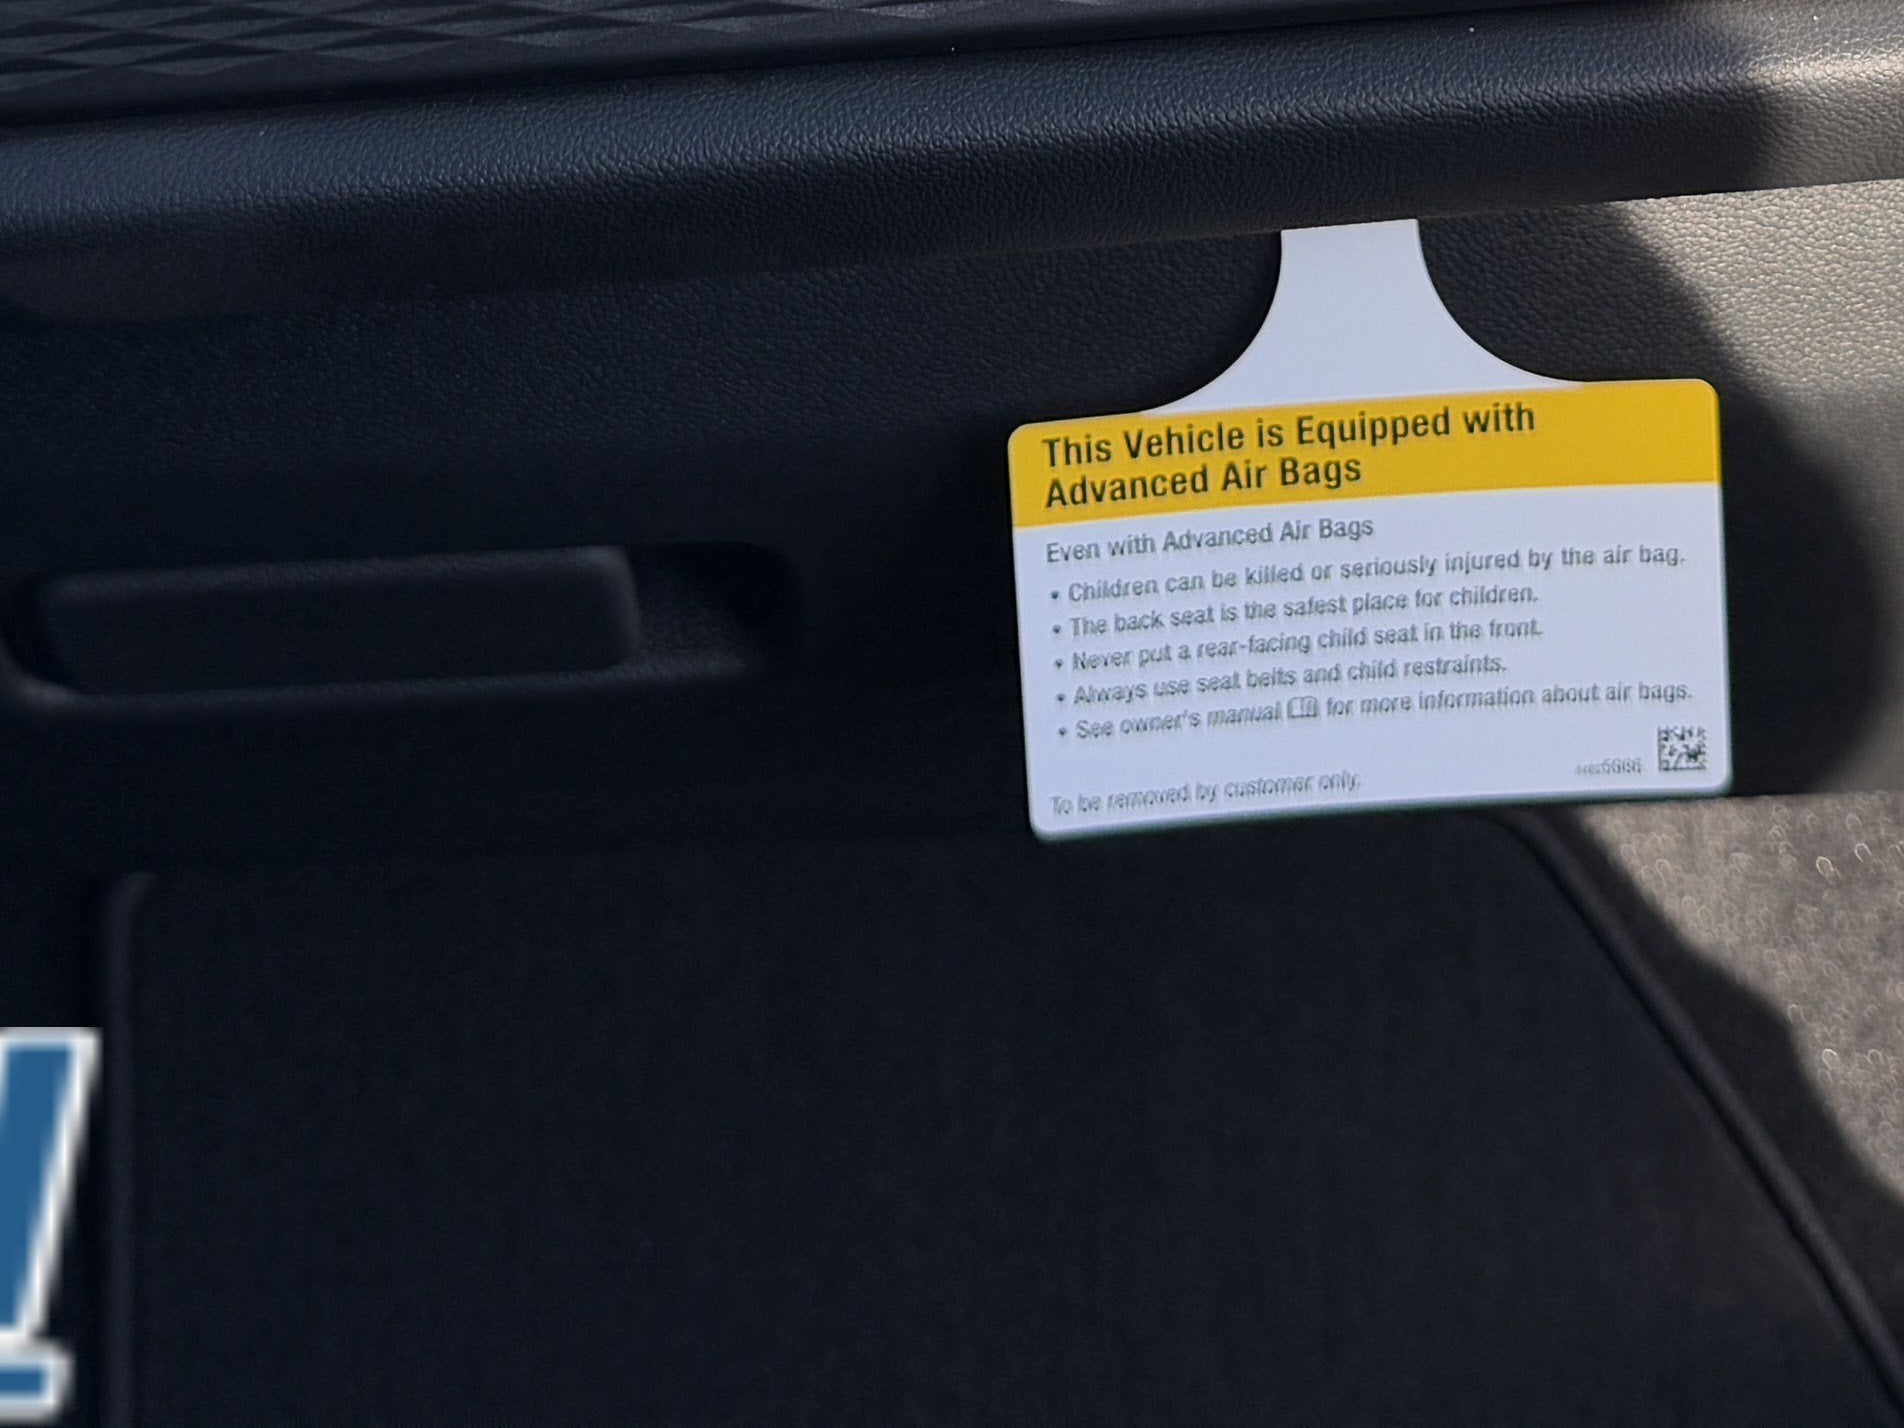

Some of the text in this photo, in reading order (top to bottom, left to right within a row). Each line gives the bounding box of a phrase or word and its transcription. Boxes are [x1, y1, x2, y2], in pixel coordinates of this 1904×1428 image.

[1043, 402, 1535, 467] This Vehicle is Equipped with
[1046, 457, 1361, 509] Advanced Air Bags
[1046, 517, 1374, 563] Even with Advanced Air Bags
[1068, 543, 1685, 602] Children can be killed or seriously injured by the air bag.
[1070, 584, 1538, 637] The back seat is the safest place for children.
[1071, 649, 1134, 671] Never
[1138, 642, 1172, 668] put
[1178, 643, 1191, 660] a
[1197, 631, 1311, 658] rear-facing
[1317, 628, 1366, 649] child
[1374, 624, 1418, 644] seat
[1424, 622, 1443, 642] in
[1450, 620, 1481, 640] the
[1073, 654, 1507, 705] Always use seat belts and child restraints.
[1076, 681, 1692, 740] See owner's manual for more information about air bags.
